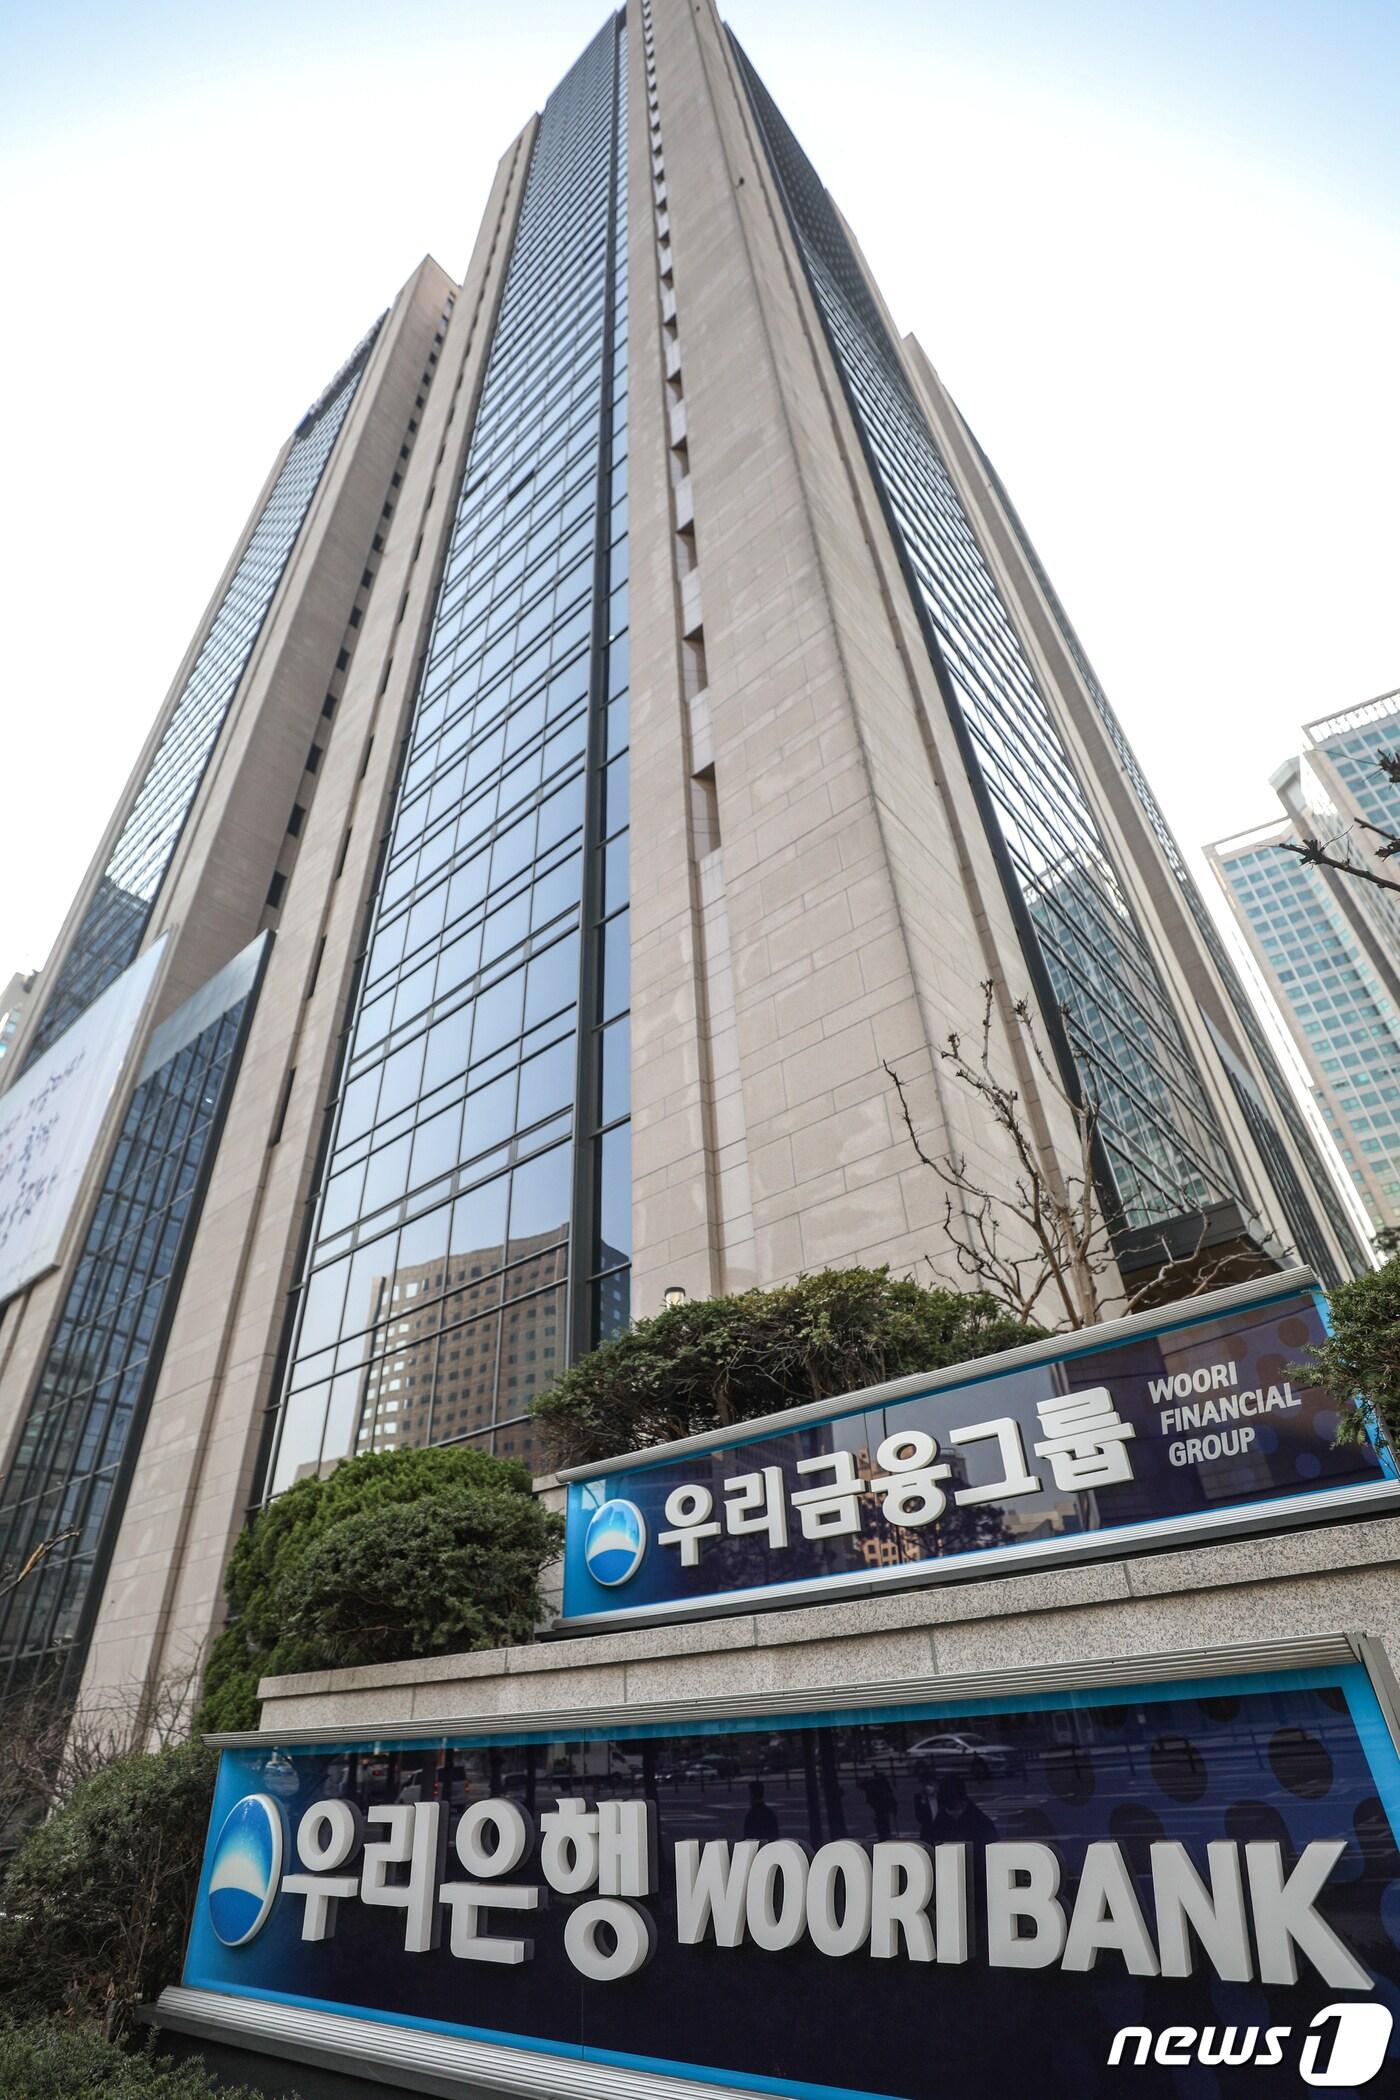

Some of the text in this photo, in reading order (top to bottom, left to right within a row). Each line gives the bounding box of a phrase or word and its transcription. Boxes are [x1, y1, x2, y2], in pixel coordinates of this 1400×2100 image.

[1148, 1360, 1239, 1405] WOORI
[1160, 1381, 1302, 1436] FINANCIAL
[1168, 1425, 1256, 1468] GROUP
[658, 1386, 1136, 1567] 우리금융그룹
[281, 1797, 1376, 1991] 우리은행 WOORI BANK
